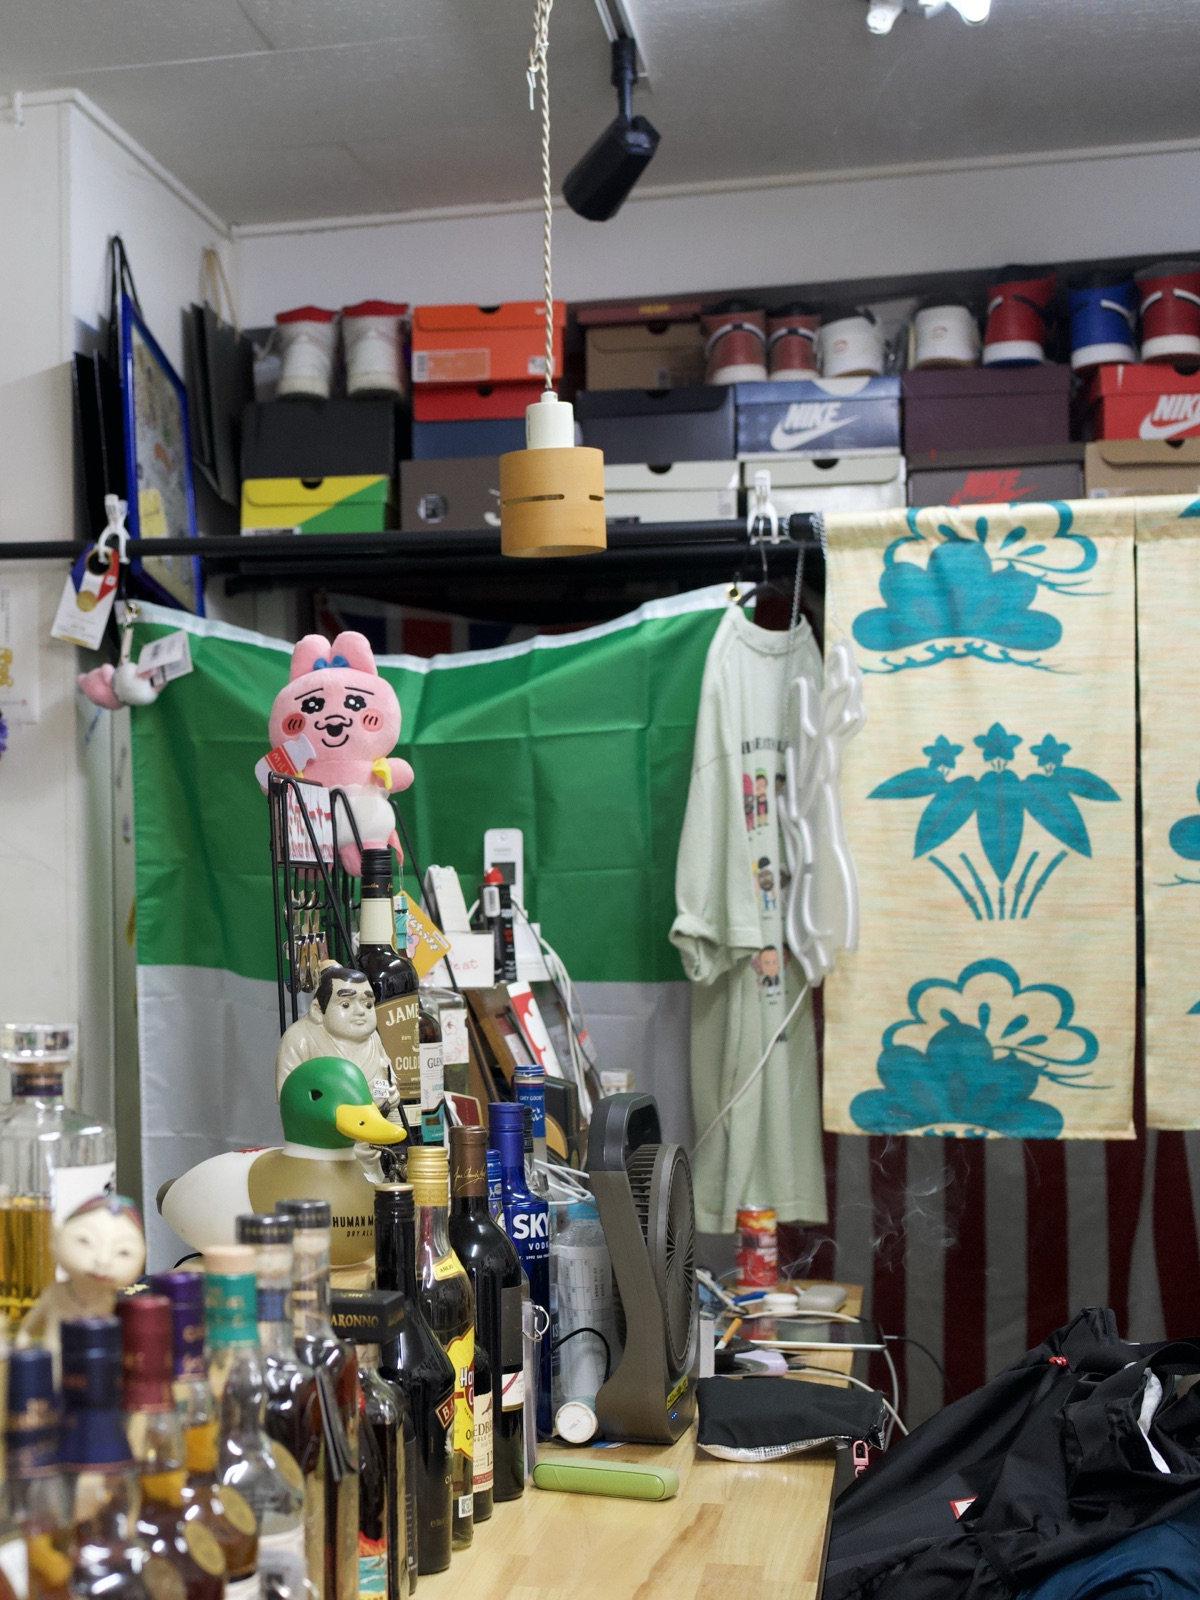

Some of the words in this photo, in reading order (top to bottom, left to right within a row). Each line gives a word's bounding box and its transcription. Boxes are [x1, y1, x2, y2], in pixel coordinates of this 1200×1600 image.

[784, 402, 842, 430] NIKE
[332, 1215, 365, 1227] HUMAN
[330, 1313, 380, 1328] ARONNO
